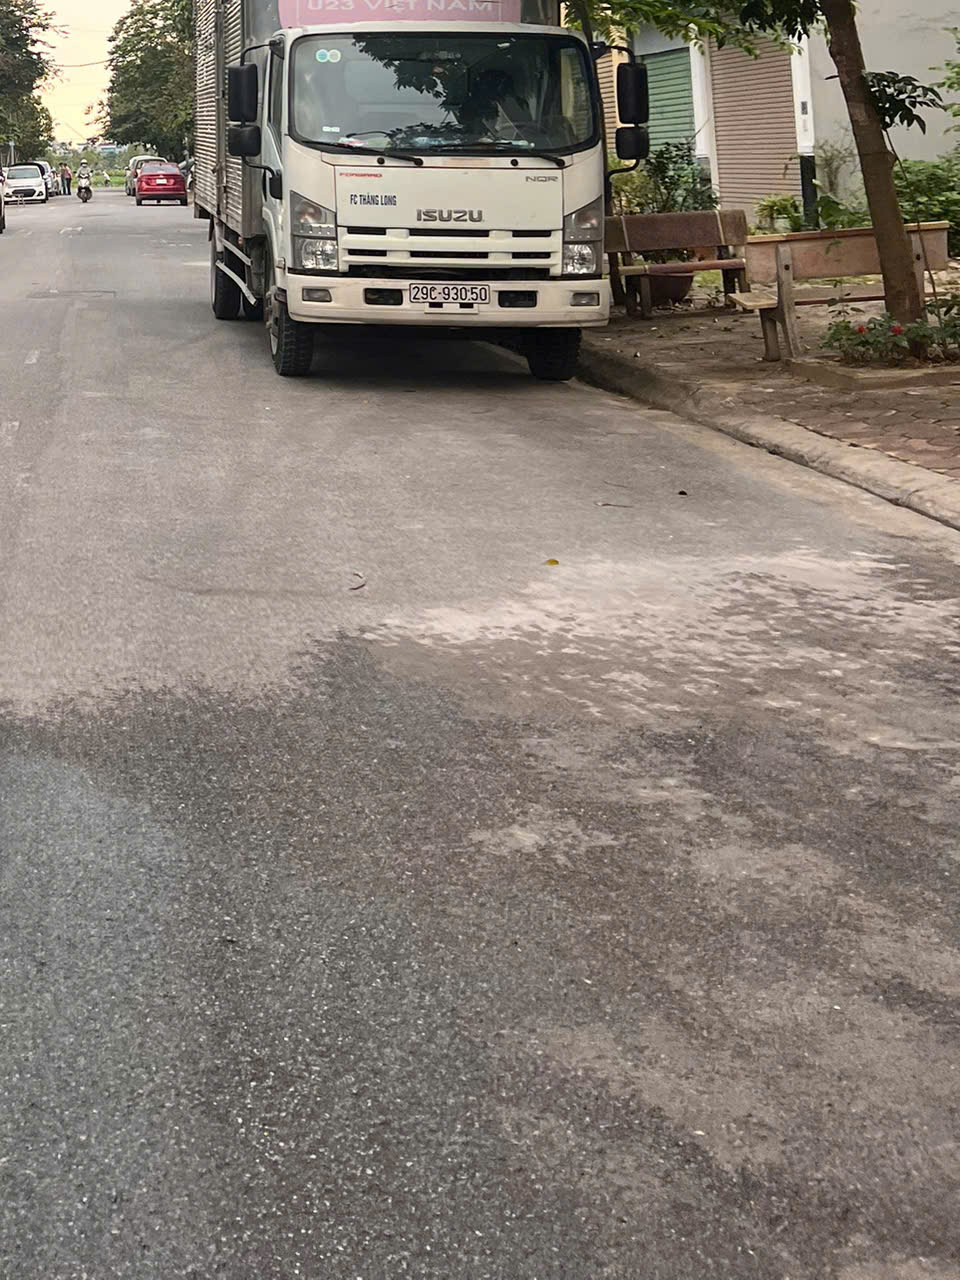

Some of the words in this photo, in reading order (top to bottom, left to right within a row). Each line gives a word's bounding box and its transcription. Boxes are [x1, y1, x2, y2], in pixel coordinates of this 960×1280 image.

[307, 0, 355, 11] U23
[427, 0, 493, 11] NAM
[350, 194, 358, 205] FC
[380, 194, 397, 206] LONG
[416, 209, 483, 223] ISUZU
